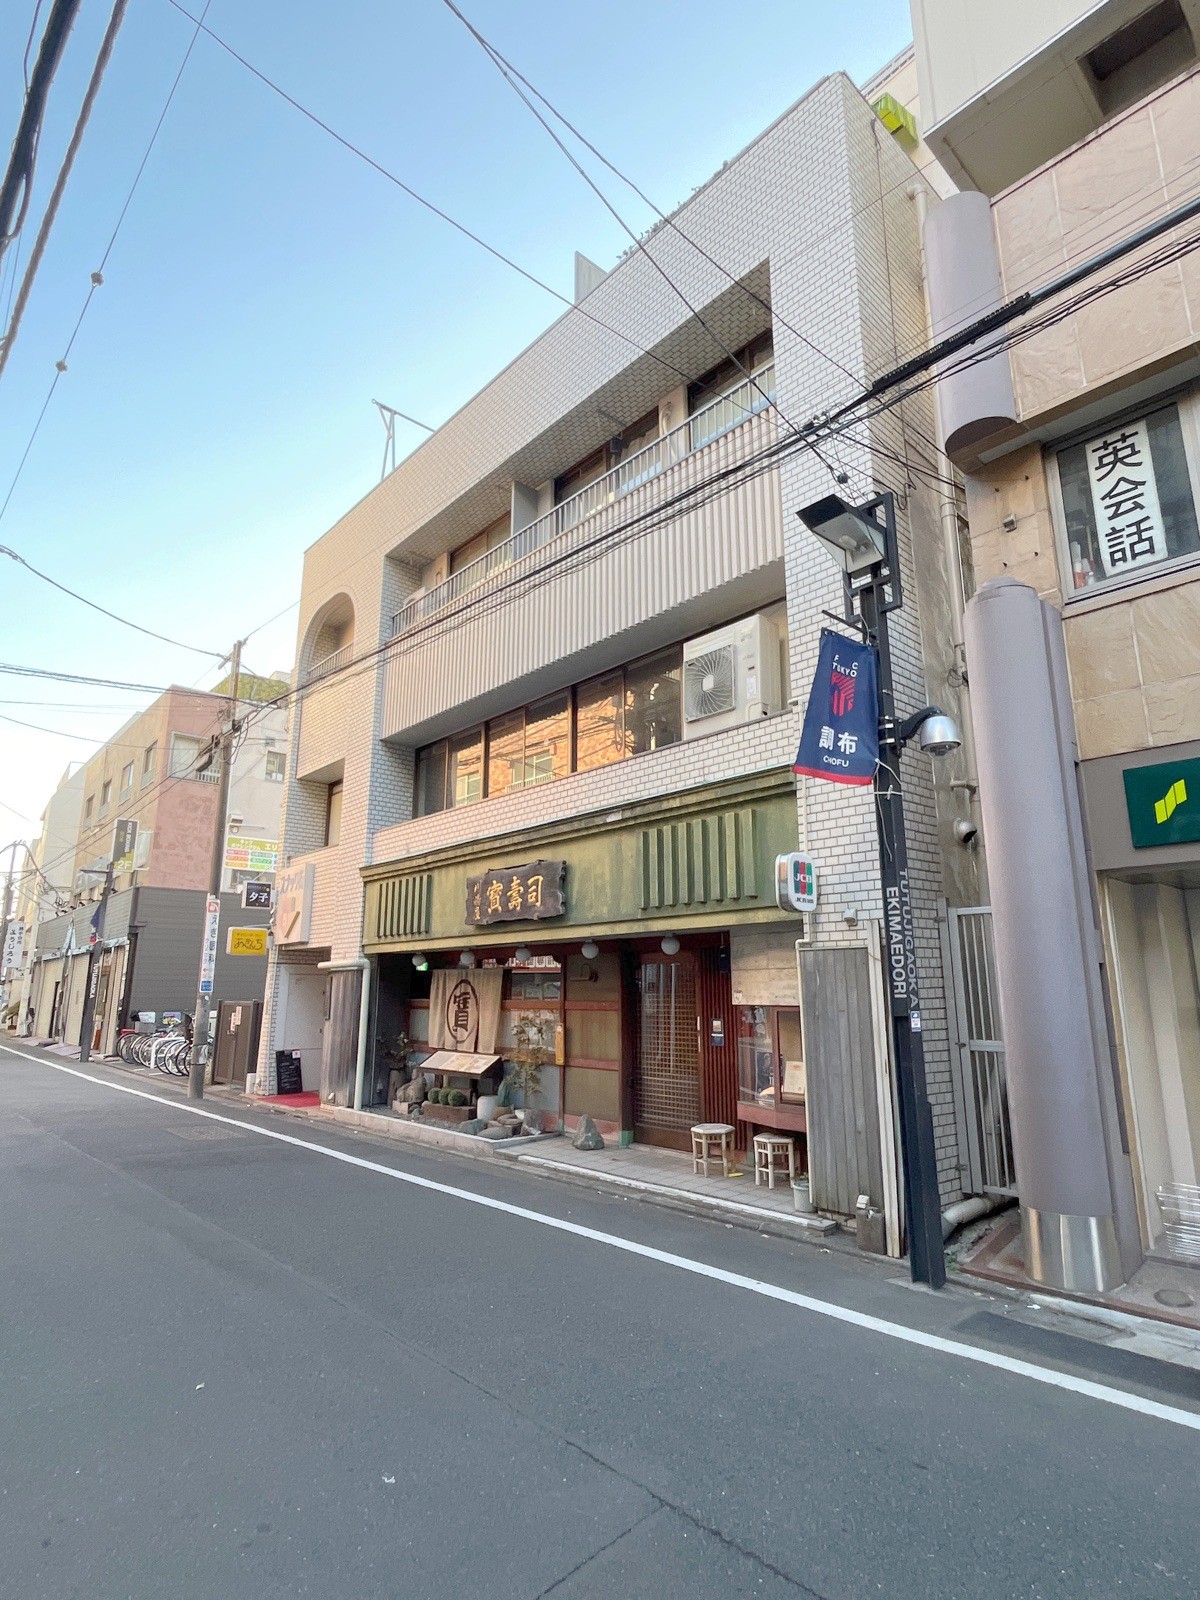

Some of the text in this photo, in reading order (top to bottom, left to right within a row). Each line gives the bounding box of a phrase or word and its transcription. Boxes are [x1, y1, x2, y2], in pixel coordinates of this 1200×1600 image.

[1091, 431, 1156, 567] 英会話
[832, 662, 858, 678] TOKYO
[819, 725, 859, 755] 調布
[822, 755, 850, 768] CHOFU
[118, 860, 132, 870] 2F
[794, 873, 813, 884] JCB
[886, 886, 908, 999] EKIMAEDORI
[899, 868, 919, 1008] TUTUJIGAOKA
